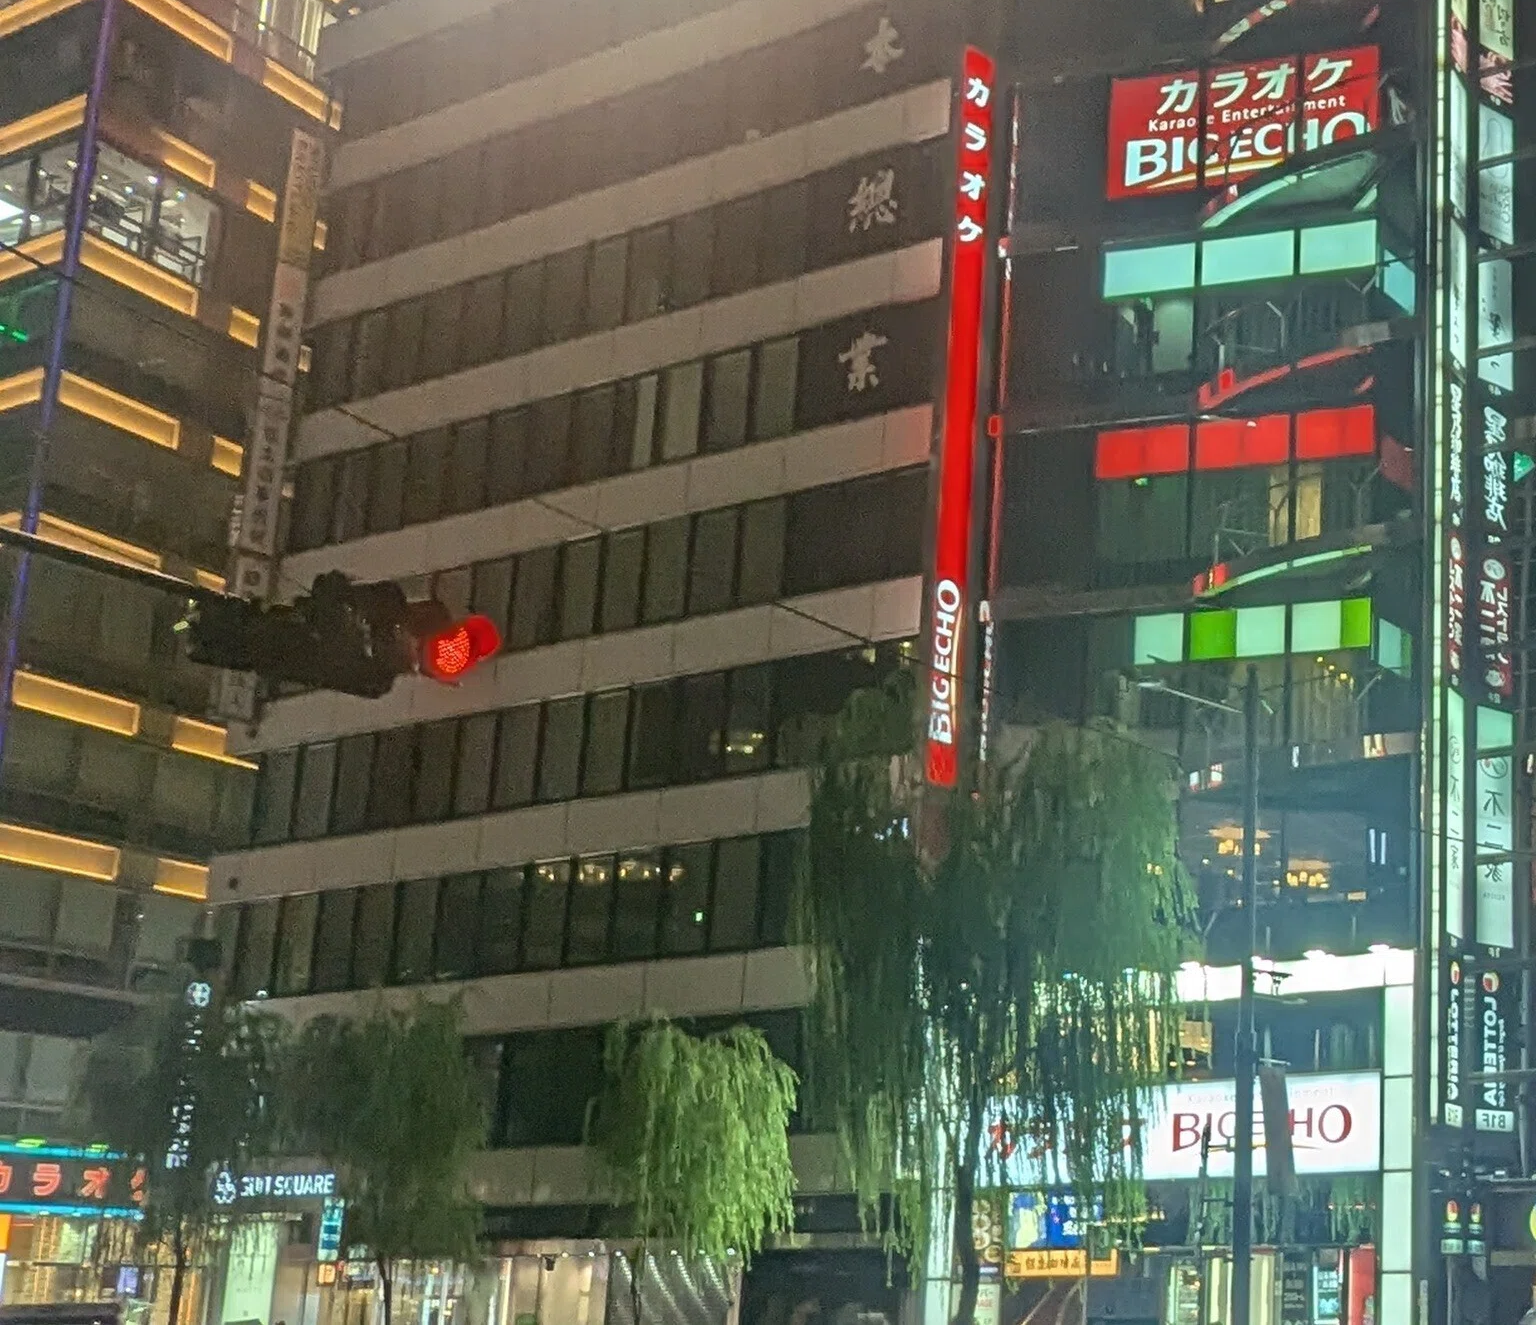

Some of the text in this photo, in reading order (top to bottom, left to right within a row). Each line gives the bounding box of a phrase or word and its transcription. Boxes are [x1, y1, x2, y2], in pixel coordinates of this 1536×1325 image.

[1157, 56, 1353, 116] カラオケ
[1124, 110, 1372, 188] BIG ECHO
[1148, 112, 1215, 133] Karaoe
[956, 76, 991, 243] カラオケ
[927, 578, 961, 745] BIG ECHO
[1252, 1103, 1353, 1145] EHO
